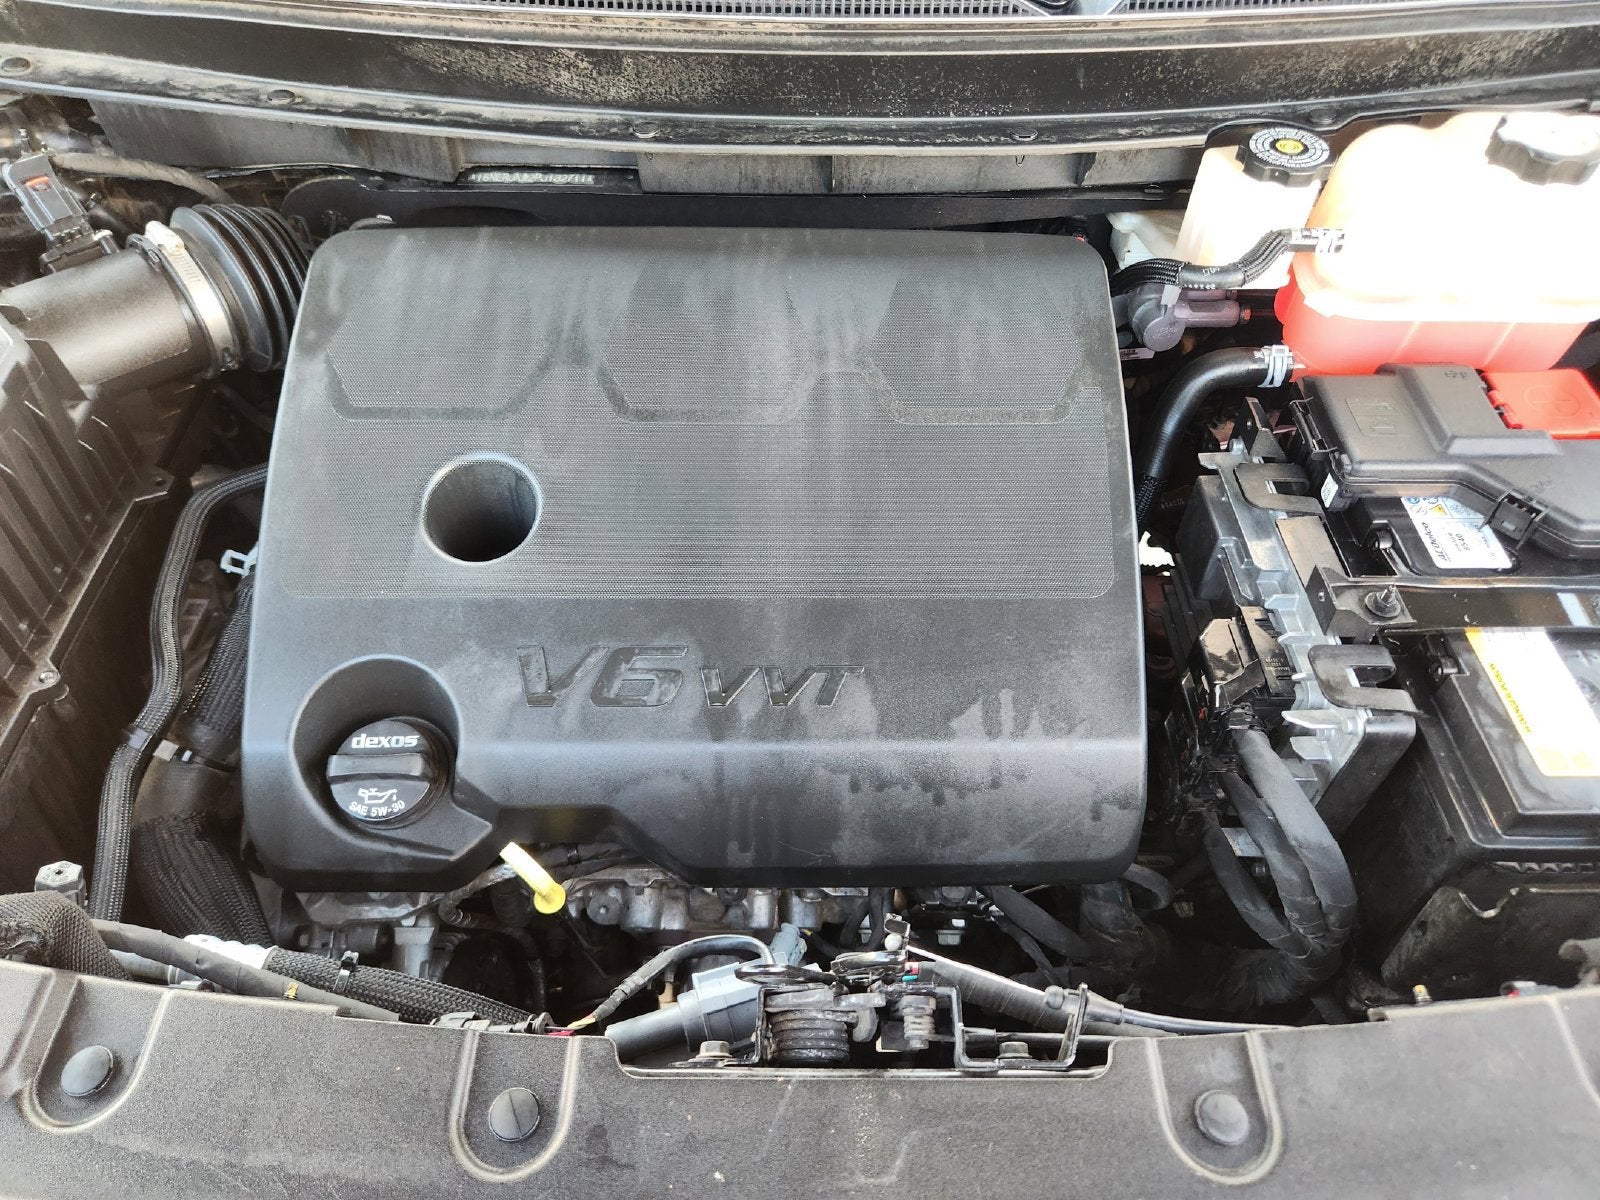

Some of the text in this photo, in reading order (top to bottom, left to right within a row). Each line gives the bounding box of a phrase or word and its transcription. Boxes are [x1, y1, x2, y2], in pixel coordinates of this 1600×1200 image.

[516, 644, 865, 707] V6 VVT
[351, 733, 420, 749] dexos
[349, 800, 406, 817] SAE 5W-30
